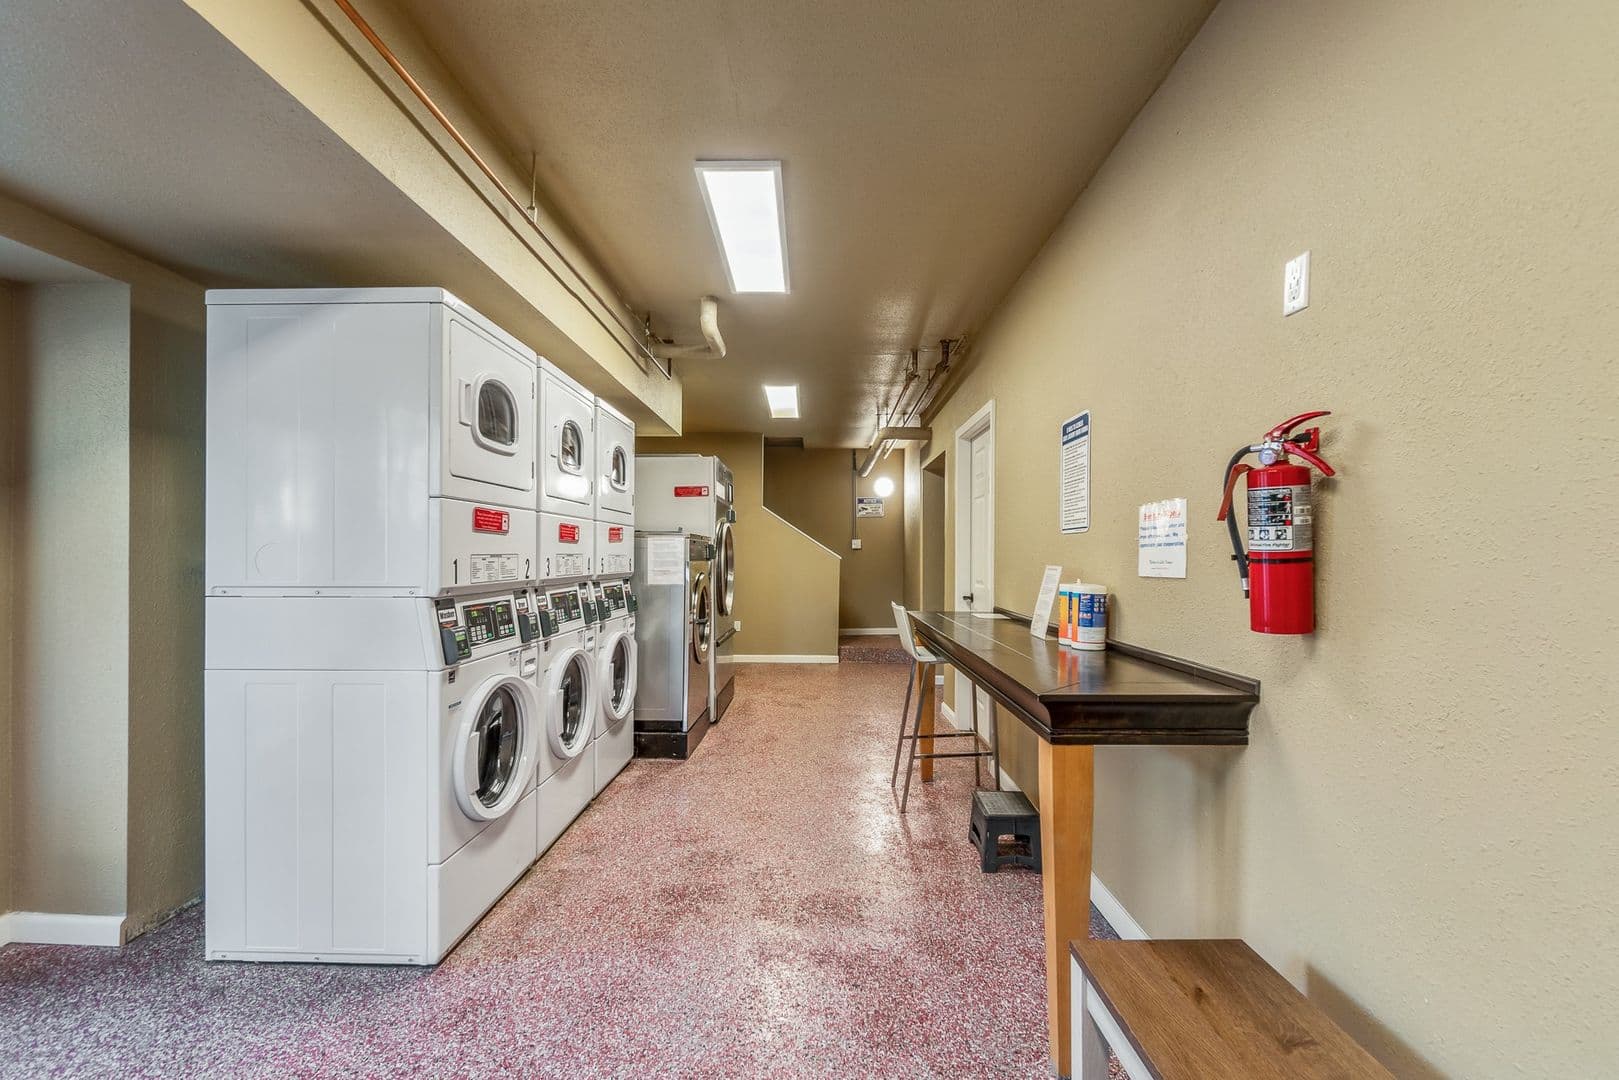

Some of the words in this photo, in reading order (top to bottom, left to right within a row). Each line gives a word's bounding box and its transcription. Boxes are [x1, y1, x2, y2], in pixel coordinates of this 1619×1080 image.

[453, 558, 458, 584] 1
[525, 558, 530, 579] 2
[546, 557, 550, 577] 3
